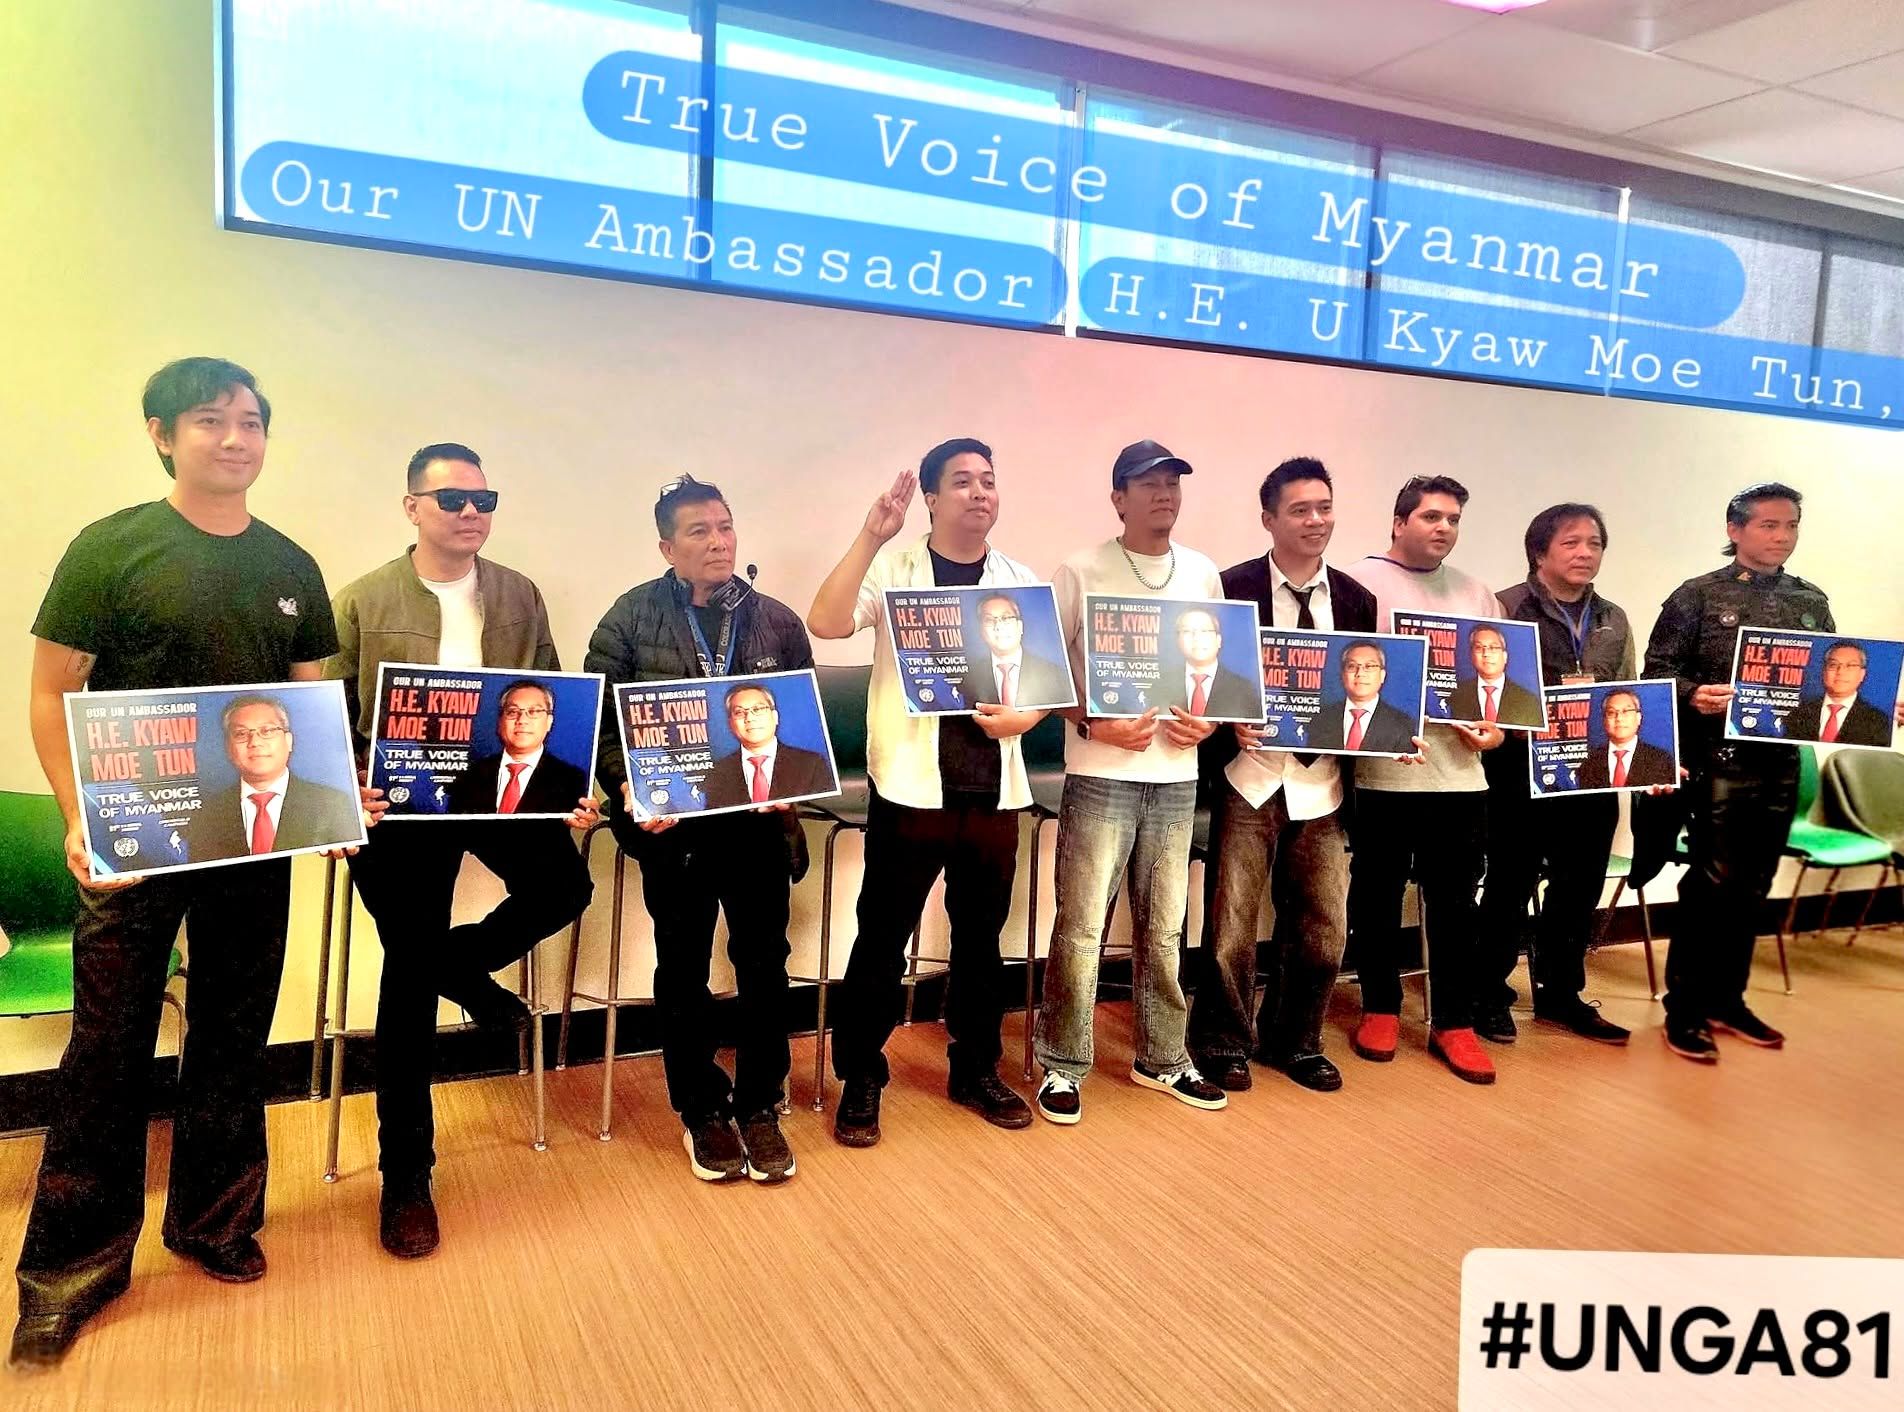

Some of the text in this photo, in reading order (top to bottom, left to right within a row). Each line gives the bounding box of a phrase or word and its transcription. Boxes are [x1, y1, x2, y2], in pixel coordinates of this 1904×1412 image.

[896, 607, 961, 627] H.E. KYAW
[1095, 613, 1160, 633] H.E. KYAW
[900, 629, 963, 649] MOE TUN
[1095, 635, 1158, 654] MOE TUN
[906, 658, 934, 666] TRUE
[1288, 649, 1326, 668] KYAW
[1433, 649, 1455, 666] TUN
[1745, 645, 1810, 666] H.E. KYAW
[909, 666, 968, 674] OF MYANMAR
[1096, 661, 1159, 670] TRUE VOICE
[394, 677, 481, 689] OUR UN AMBASSADOR
[1112, 671, 1160, 679] MYANMAR
[1296, 670, 1321, 689] TUN
[1430, 673, 1456, 681] VOICE
[1742, 665, 1803, 685] MOE TUN
[390, 689, 480, 715] H.E. KYAW
[1290, 697, 1320, 705] VOICE
[1740, 689, 1800, 699] TRUE VOICE
[86, 703, 197, 718] OUR UN AMBASSADOR
[1274, 705, 1320, 713] MYANMAR
[1558, 701, 1590, 719] KYAW
[1753, 698, 1799, 707] MYANMAR
[630, 700, 707, 725] H.E. KYAW
[86, 717, 196, 750] H.E. KYAW
[387, 716, 472, 741] MOE TUN
[632, 723, 708, 748] MOE TUN
[1566, 721, 1587, 737] TUN
[386, 750, 468, 760] TRUE VOICE
[1537, 744, 1587, 754] TRUE VOICE
[1550, 752, 1588, 760] MYANMAR
[91, 748, 195, 781] MOE TUN
[384, 761, 468, 771] OF MYANMAR
[638, 752, 711, 765] TRUE VOICE
[639, 762, 714, 775] OF MYANMAR
[97, 787, 199, 805] TRUE VOICE
[99, 800, 202, 819] OF MYANMAR
